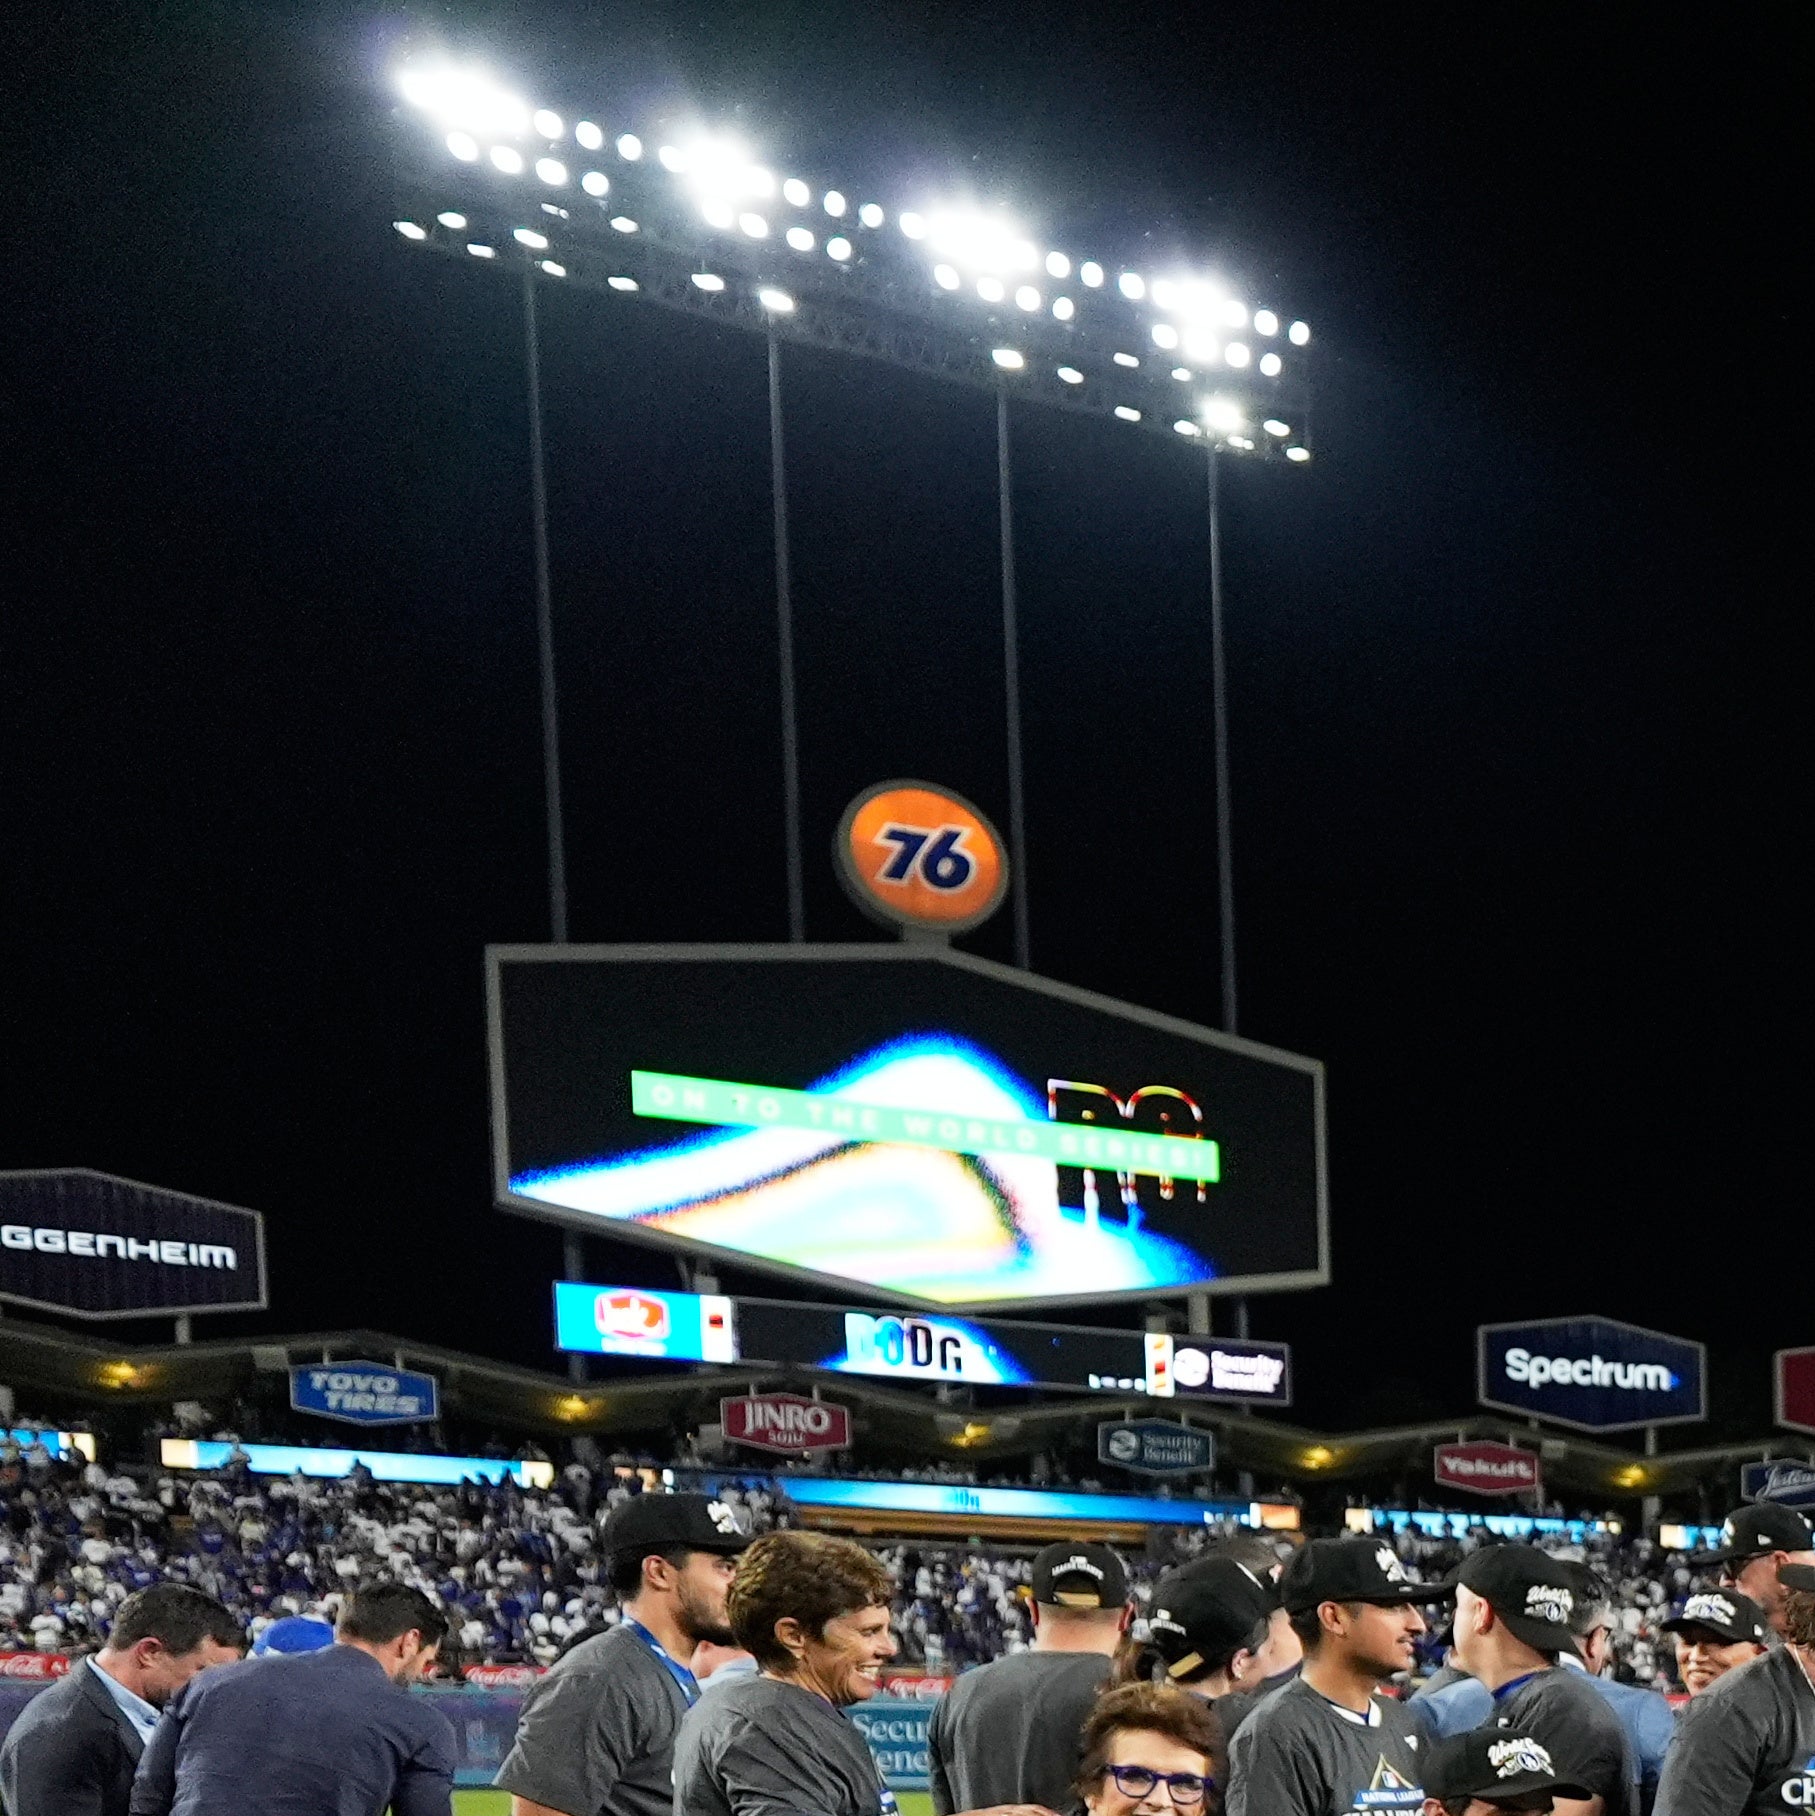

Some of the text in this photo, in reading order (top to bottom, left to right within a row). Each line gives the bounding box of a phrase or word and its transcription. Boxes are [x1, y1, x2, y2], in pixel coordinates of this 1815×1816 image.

[873, 822, 979, 895] 76
[0, 1224, 238, 1271] GGENHEIM
[1504, 1347, 1673, 1391] Spectrum
[744, 1401, 832, 1435] JINRO
[853, 1712, 930, 1743] Secu
